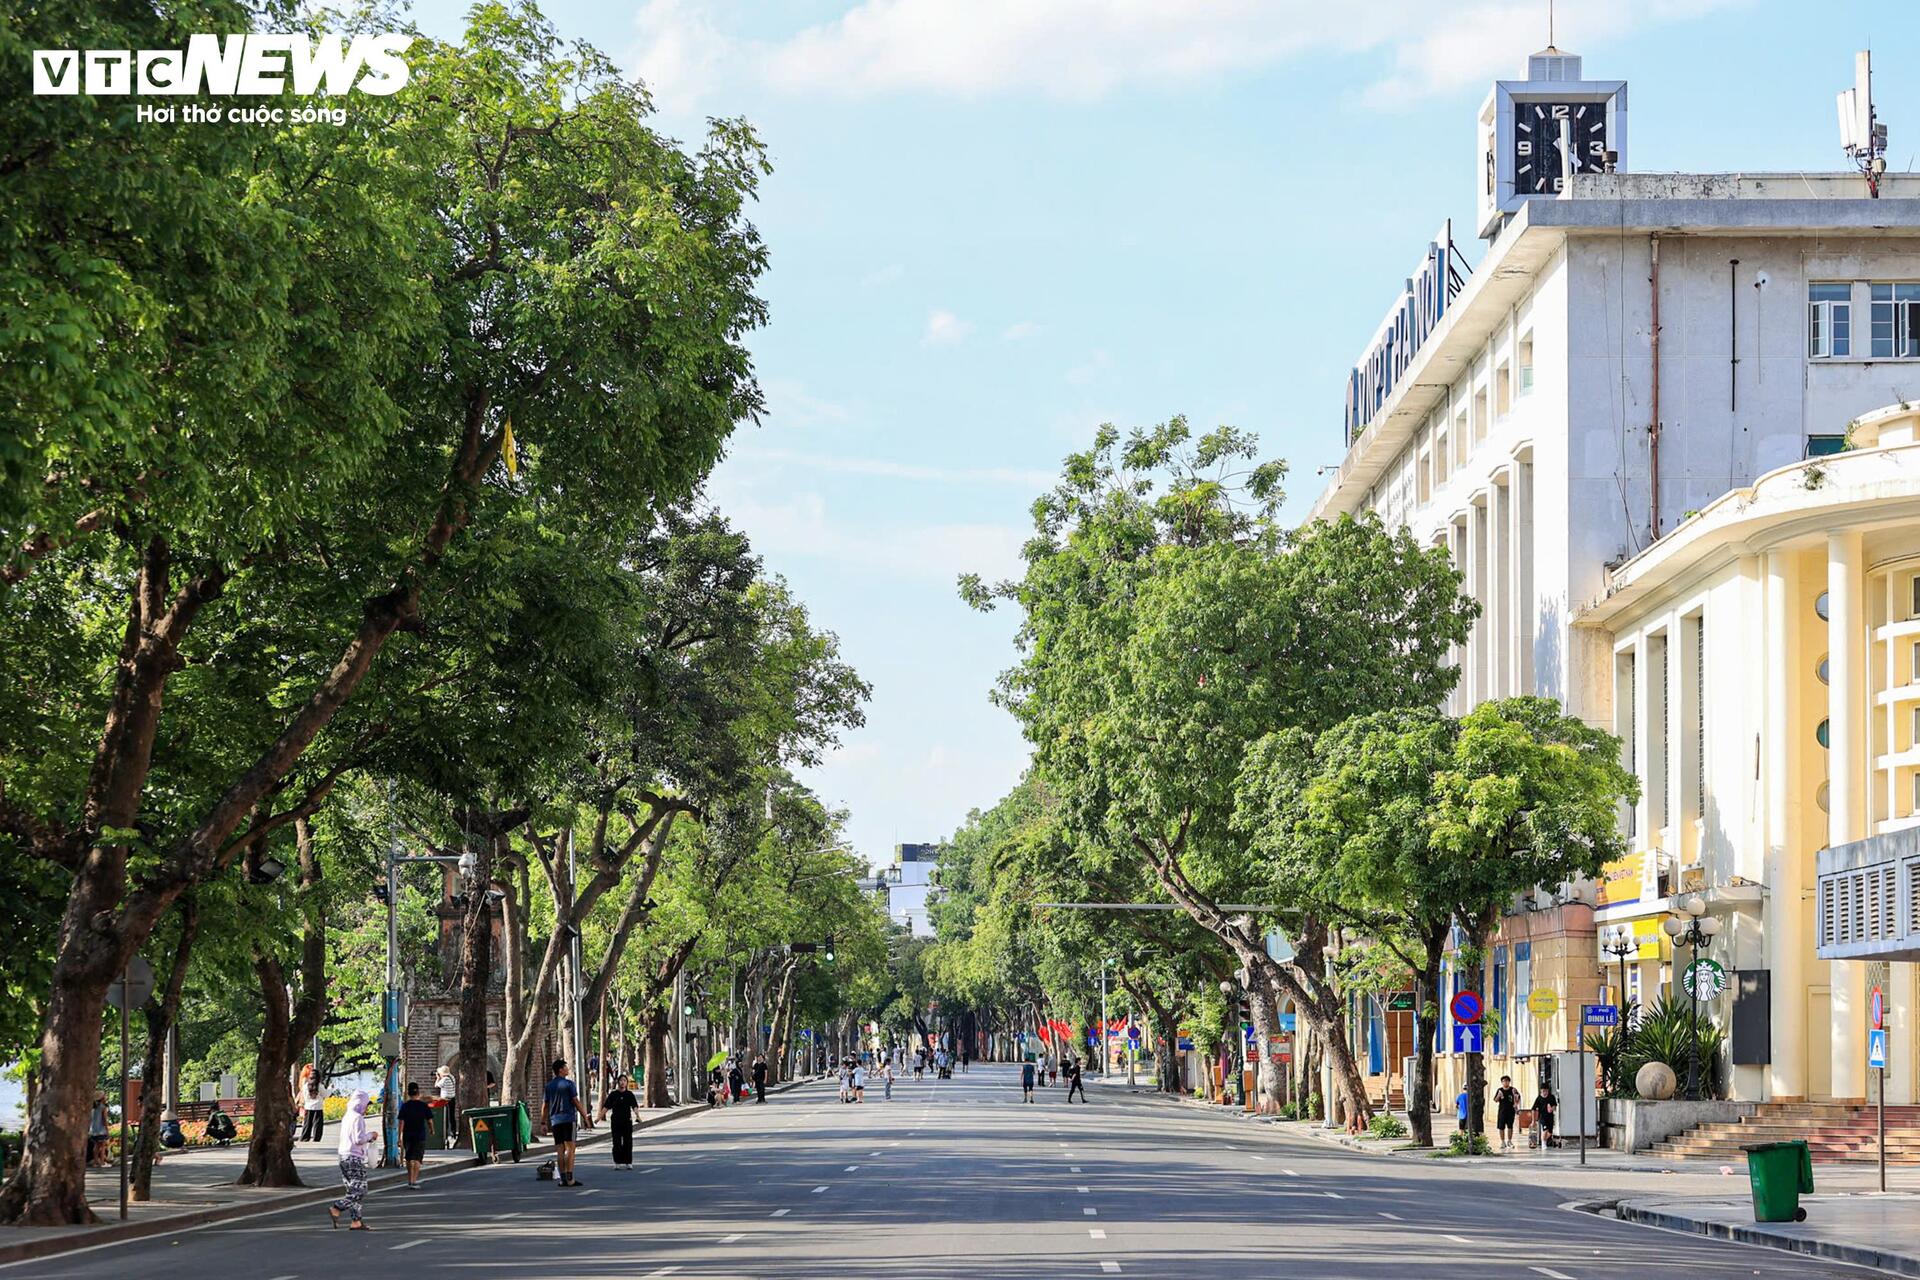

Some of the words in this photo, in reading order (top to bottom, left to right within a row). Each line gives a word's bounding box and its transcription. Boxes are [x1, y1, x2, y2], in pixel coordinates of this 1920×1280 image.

[1552, 105, 1569, 120] 12
[1517, 141, 1532, 156] 9
[1589, 141, 1604, 156] 3
